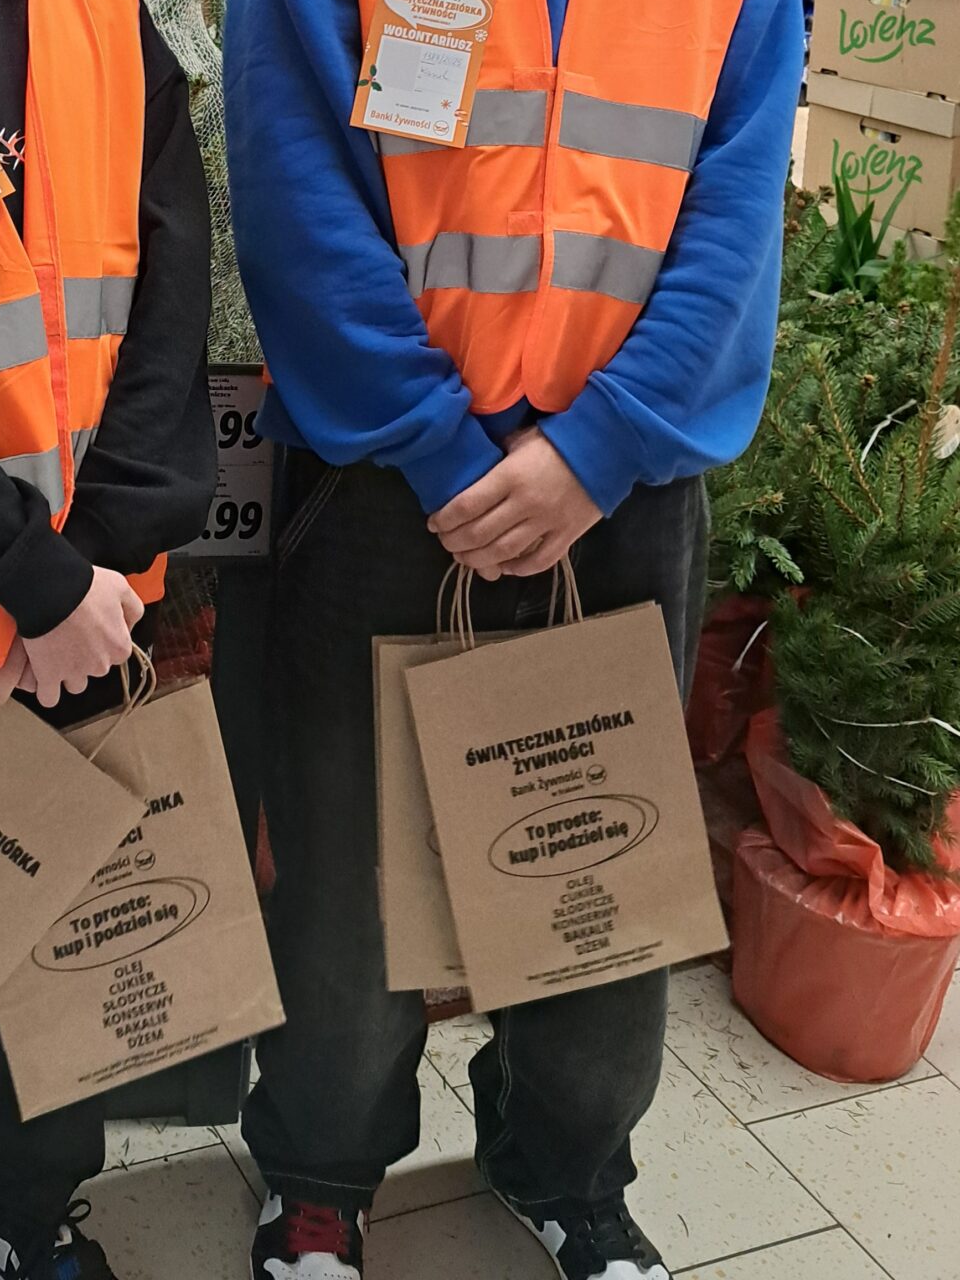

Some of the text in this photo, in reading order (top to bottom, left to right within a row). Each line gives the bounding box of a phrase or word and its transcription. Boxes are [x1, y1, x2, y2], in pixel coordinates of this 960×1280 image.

[410, 3, 457, 20] ŻYWNOŚCI
[445, 1, 483, 17] ZBIÓRKA
[383, 23, 473, 52] WOLONTARIUSZ
[839, 8, 936, 56] Lorenz
[370, 109, 432, 130] Banki Żywności
[832, 138, 924, 185] Lorenz
[218, 410, 263, 449] 99
[201, 501, 263, 540] .99
[465, 710, 634, 767] ŚWIĄTECZNA ZBIÓRKA
[513, 741, 595, 776] ŻYWNOŚCI
[510, 770, 584, 797] Bank Żywności
[142, 791, 184, 819] ÓRKA
[525, 809, 603, 841] To proste:
[509, 821, 630, 866] kup i podziel się
[560, 885, 604, 904] CUKIER
[566, 875, 594, 890] OLEJ
[70, 894, 152, 935] To proste:
[551, 904, 620, 932] KONSERWY
[553, 893, 615, 918] SŁODYCZE
[53, 902, 179, 962] kup i podziel się
[563, 919, 615, 943] BAKALIE
[108, 971, 156, 995] CUKIER
[113, 960, 144, 979] OLEJ
[102, 982, 168, 1013] SŁODYCZE
[102, 993, 174, 1030] KONSERWY
[115, 1011, 169, 1040] BAKALIE
[127, 1029, 164, 1050] DŻEM
